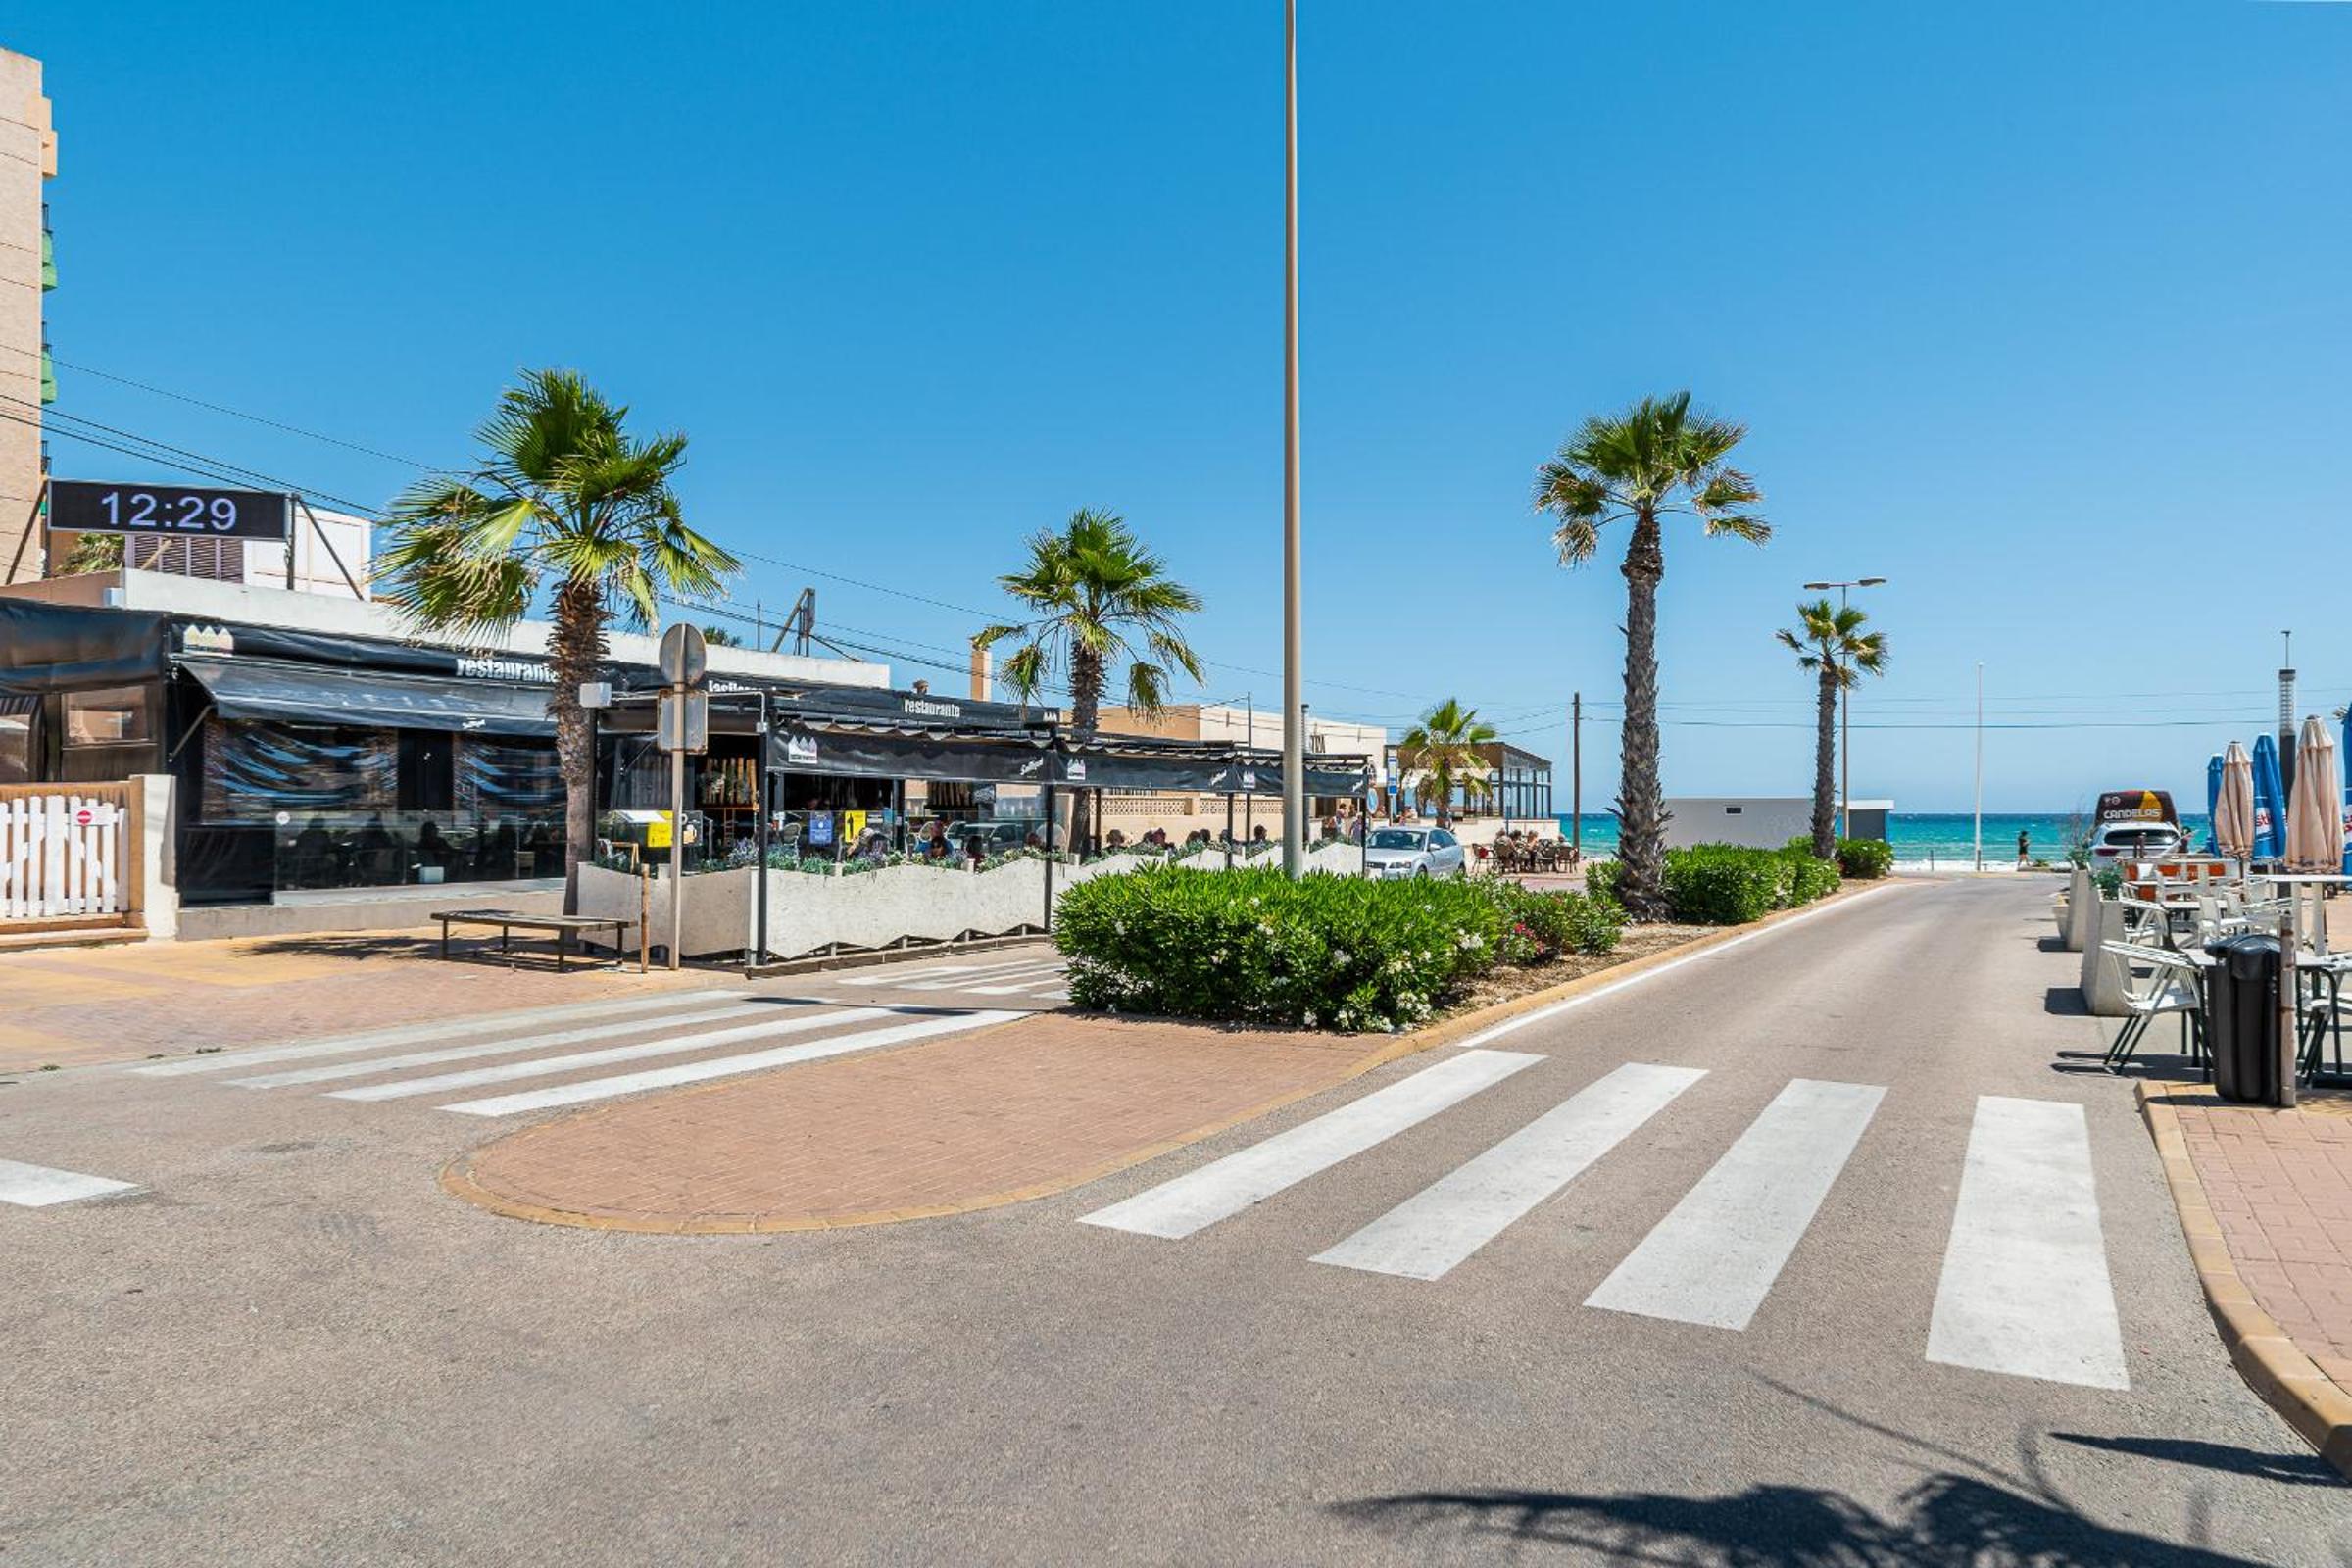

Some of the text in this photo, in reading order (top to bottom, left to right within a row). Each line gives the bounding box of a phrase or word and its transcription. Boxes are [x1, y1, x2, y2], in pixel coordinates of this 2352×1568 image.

[102, 491, 237, 531] 12:29
[457, 658, 561, 683] restaurante
[905, 699, 960, 717] restaurante
[2103, 808, 2163, 819] CANDELAS
